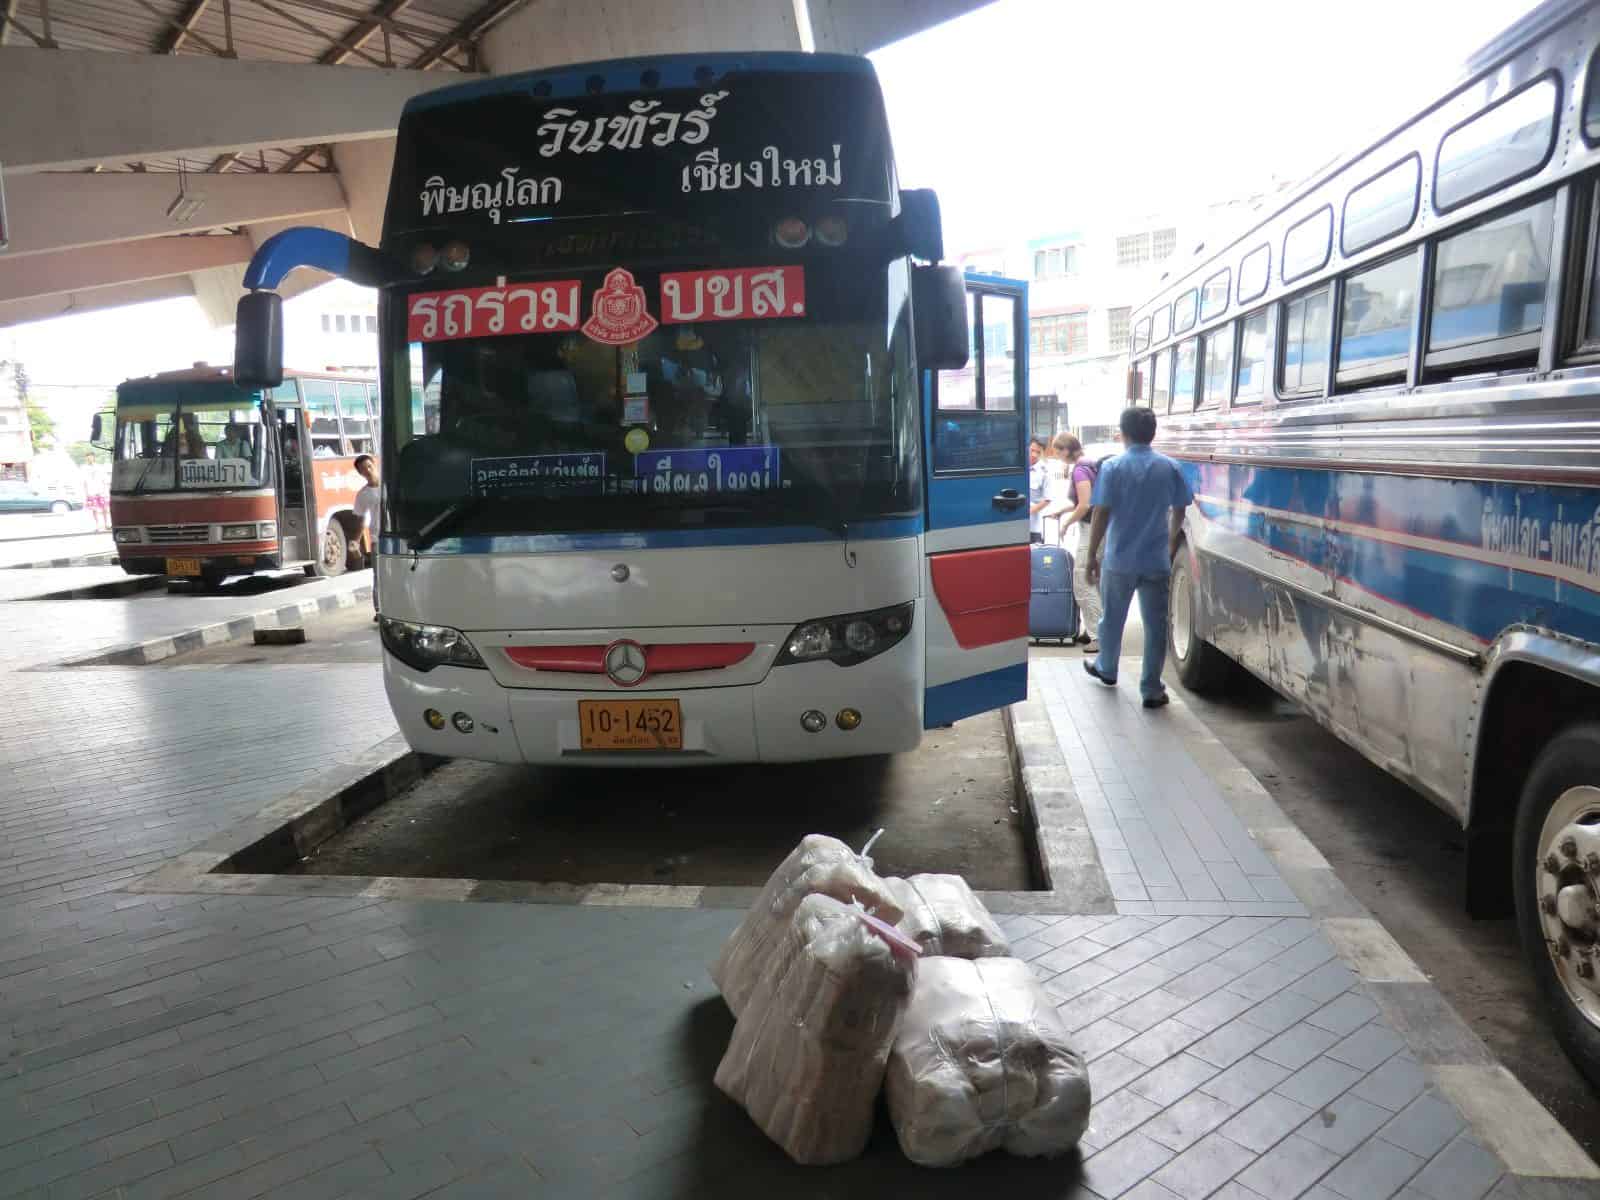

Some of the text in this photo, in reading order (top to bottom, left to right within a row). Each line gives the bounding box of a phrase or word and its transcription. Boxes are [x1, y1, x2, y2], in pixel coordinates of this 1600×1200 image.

[537, 90, 730, 158] วินทัวร์
[419, 166, 563, 225] พิษณุโลก
[680, 143, 843, 194] เชียงใหม่
[410, 268, 805, 338] รถร่วม บขส.
[589, 708, 674, 733] 10-1452
